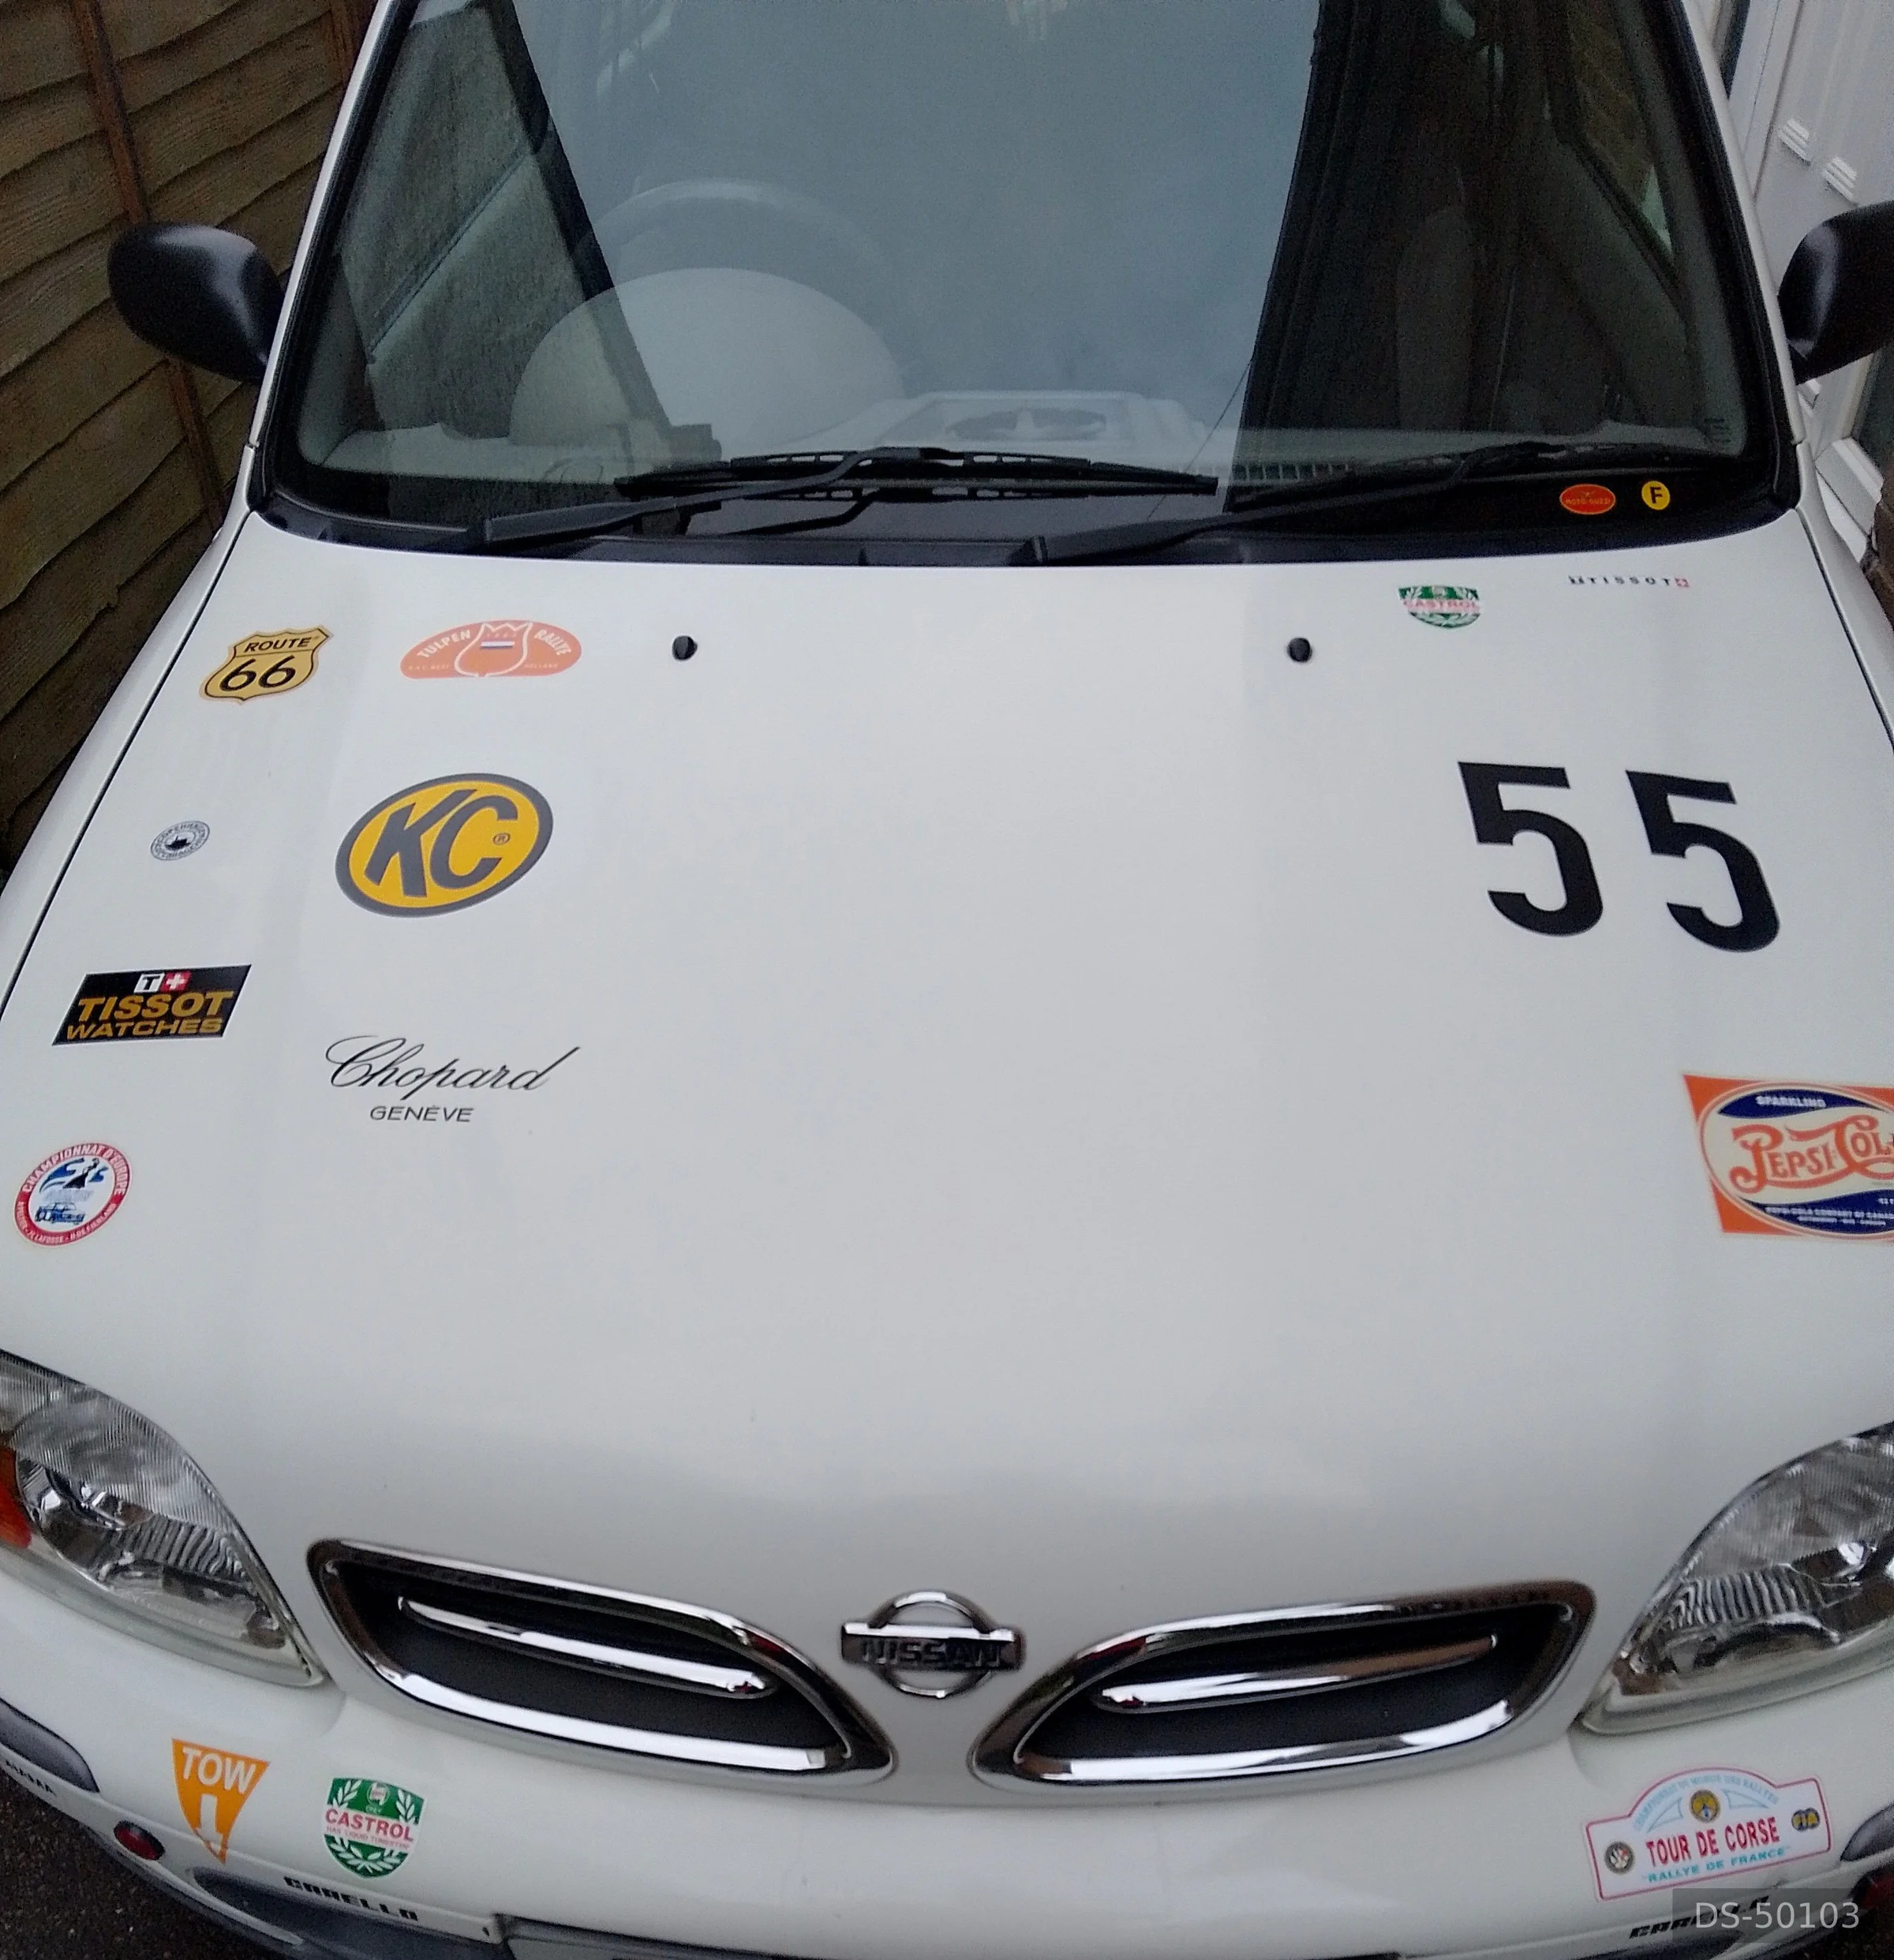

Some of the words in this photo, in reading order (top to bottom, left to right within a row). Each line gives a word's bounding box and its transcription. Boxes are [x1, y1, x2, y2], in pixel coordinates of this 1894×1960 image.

[1650, 486, 1663, 503] F
[244, 637, 313, 653] ROUTE
[417, 630, 470, 657] TULPEN
[219, 646, 297, 691] 66
[364, 789, 518, 898] KC
[79, 991, 234, 1023] TISSOT
[66, 1018, 223, 1040] WATCHES
[325, 1035, 580, 1100] Chopard
[22, 1143, 105, 1192] CHAMPIONNAT
[103, 1147, 127, 1195] D'EUROPE
[862, 1638, 1001, 1667] NISSAN
[182, 1746, 256, 1794] TOW
[325, 1809, 414, 1842] CASTROL
[1645, 1834, 1692, 1868] TOUR
[1695, 1828, 1720, 1857] DE
[1724, 1816, 1780, 1852] CORSE
[1706, 1860, 1724, 1870] DE
